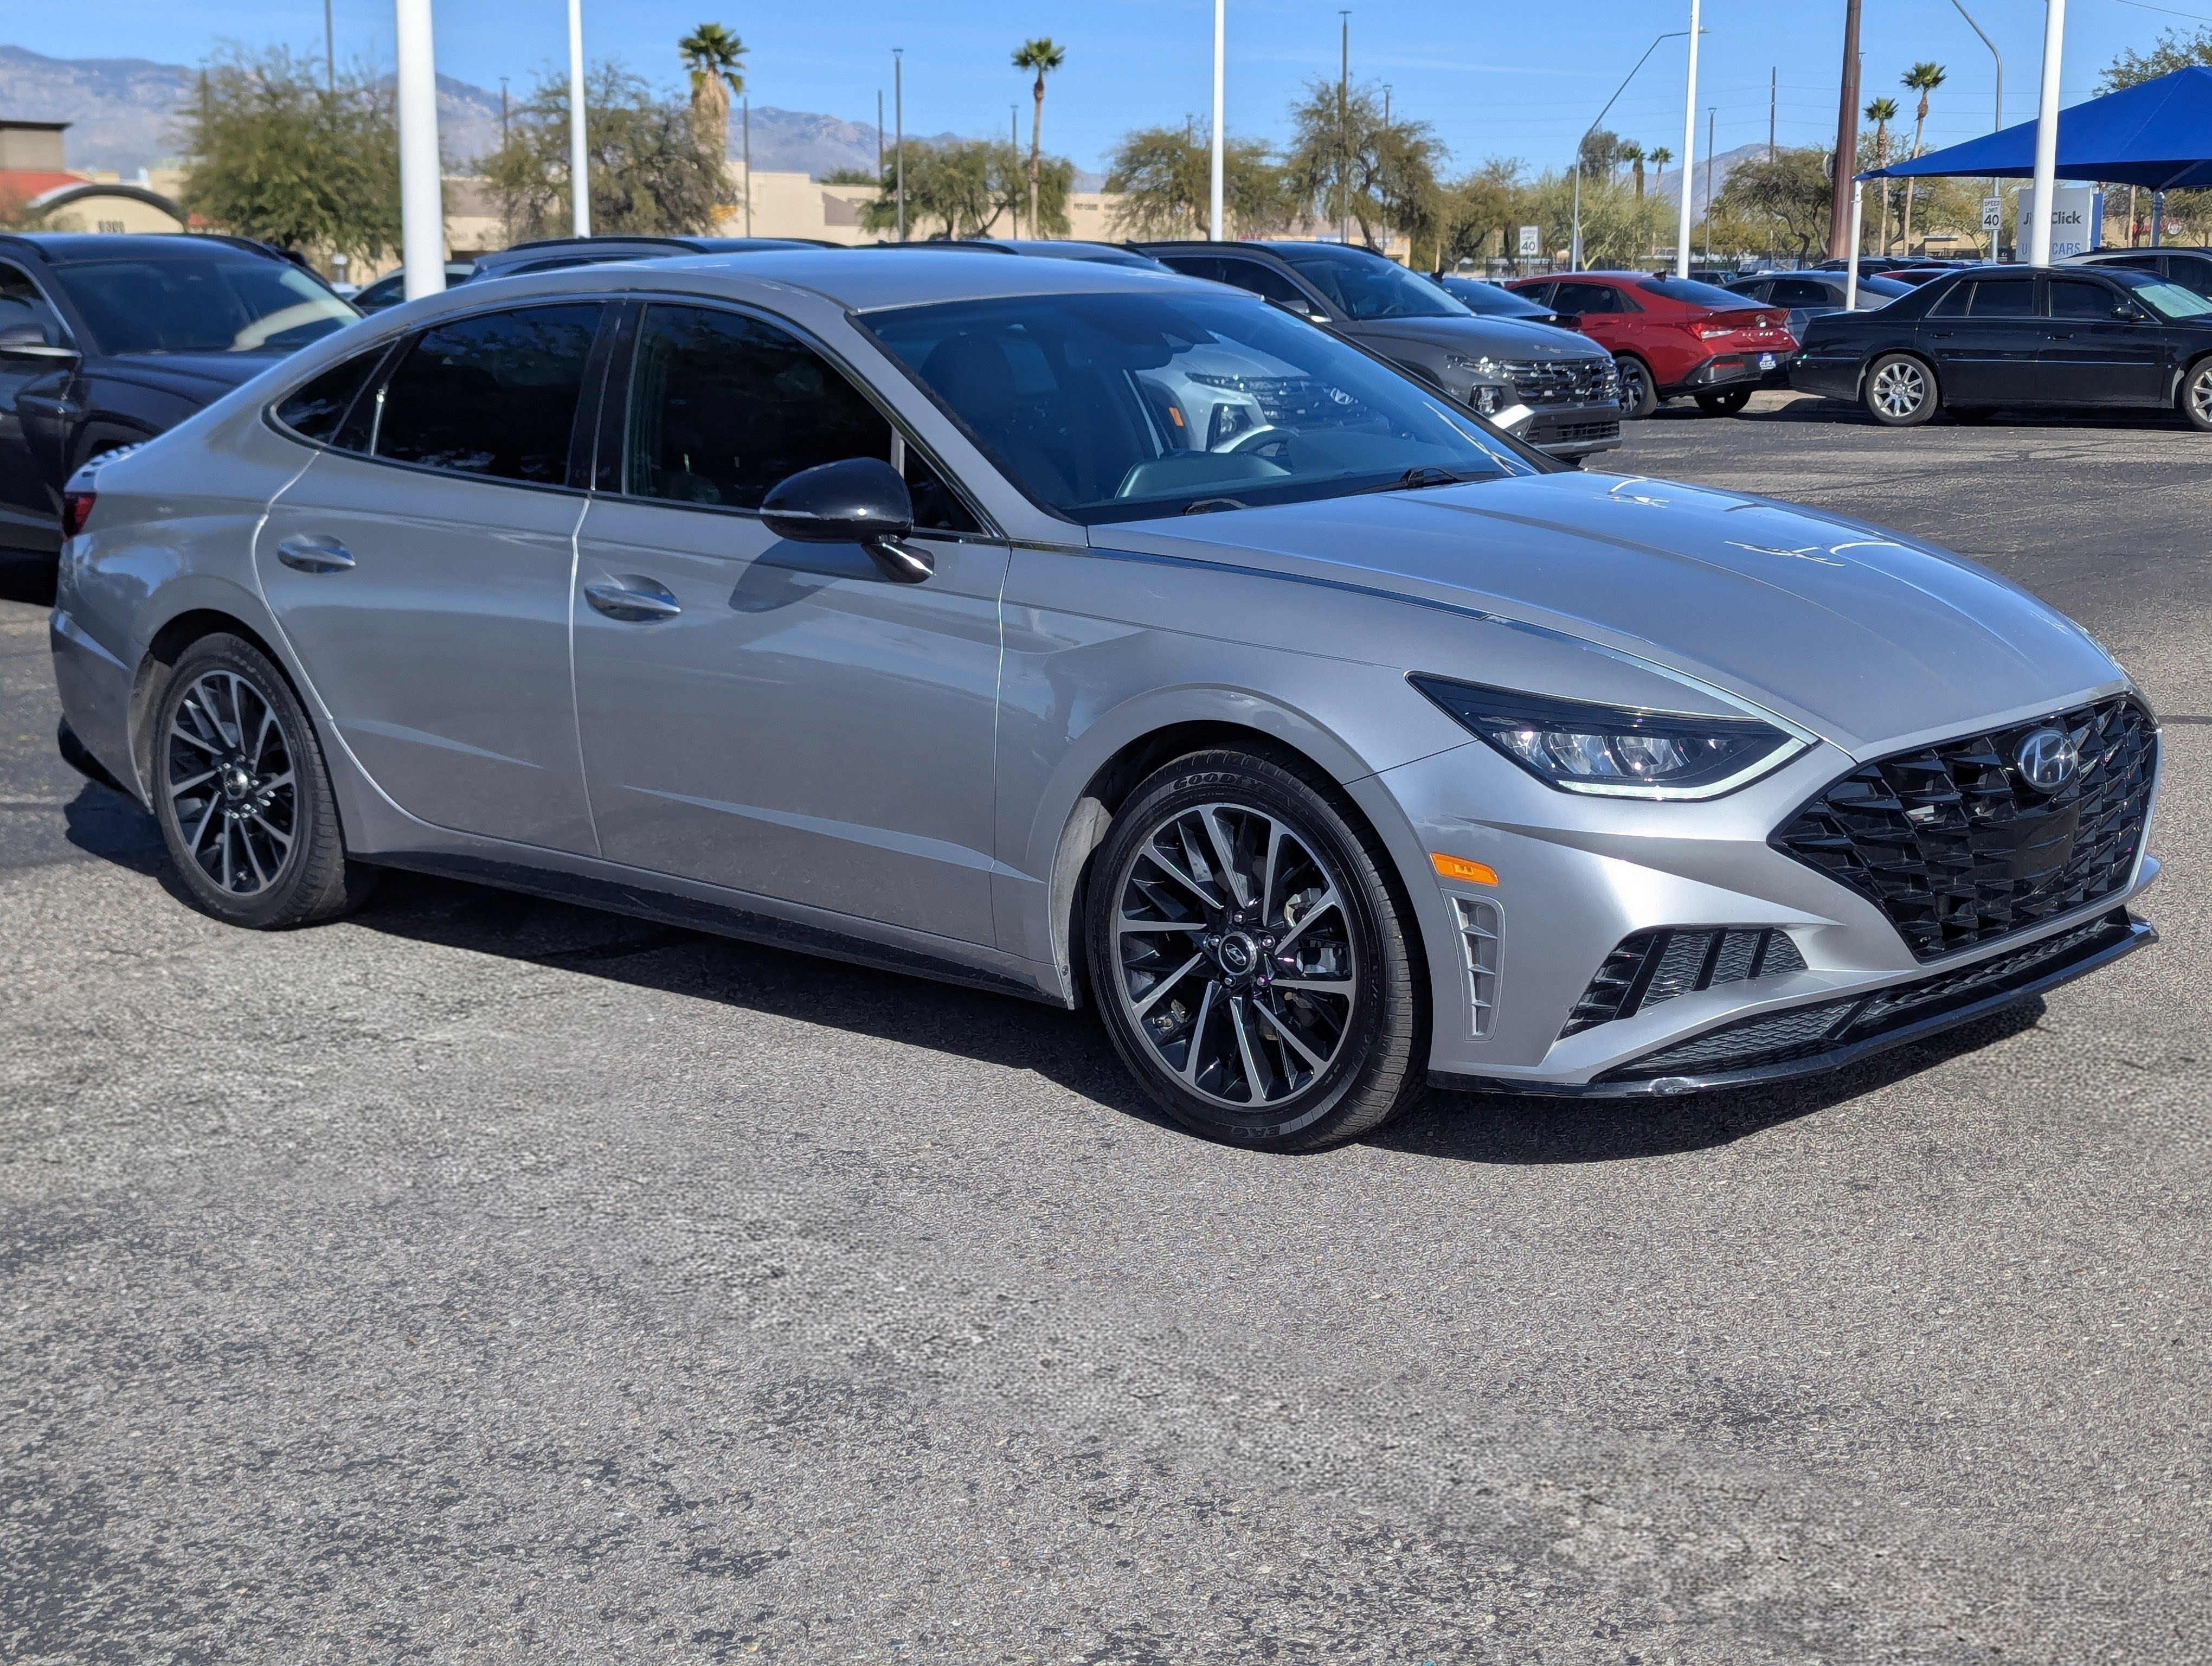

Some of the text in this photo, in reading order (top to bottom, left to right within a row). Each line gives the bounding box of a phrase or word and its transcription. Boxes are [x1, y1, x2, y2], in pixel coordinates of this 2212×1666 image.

[1984, 214, 1999, 226] 40
[2051, 210, 2081, 225] Click
[1521, 241, 1535, 251] 40
[2052, 242, 2081, 255] CARS
